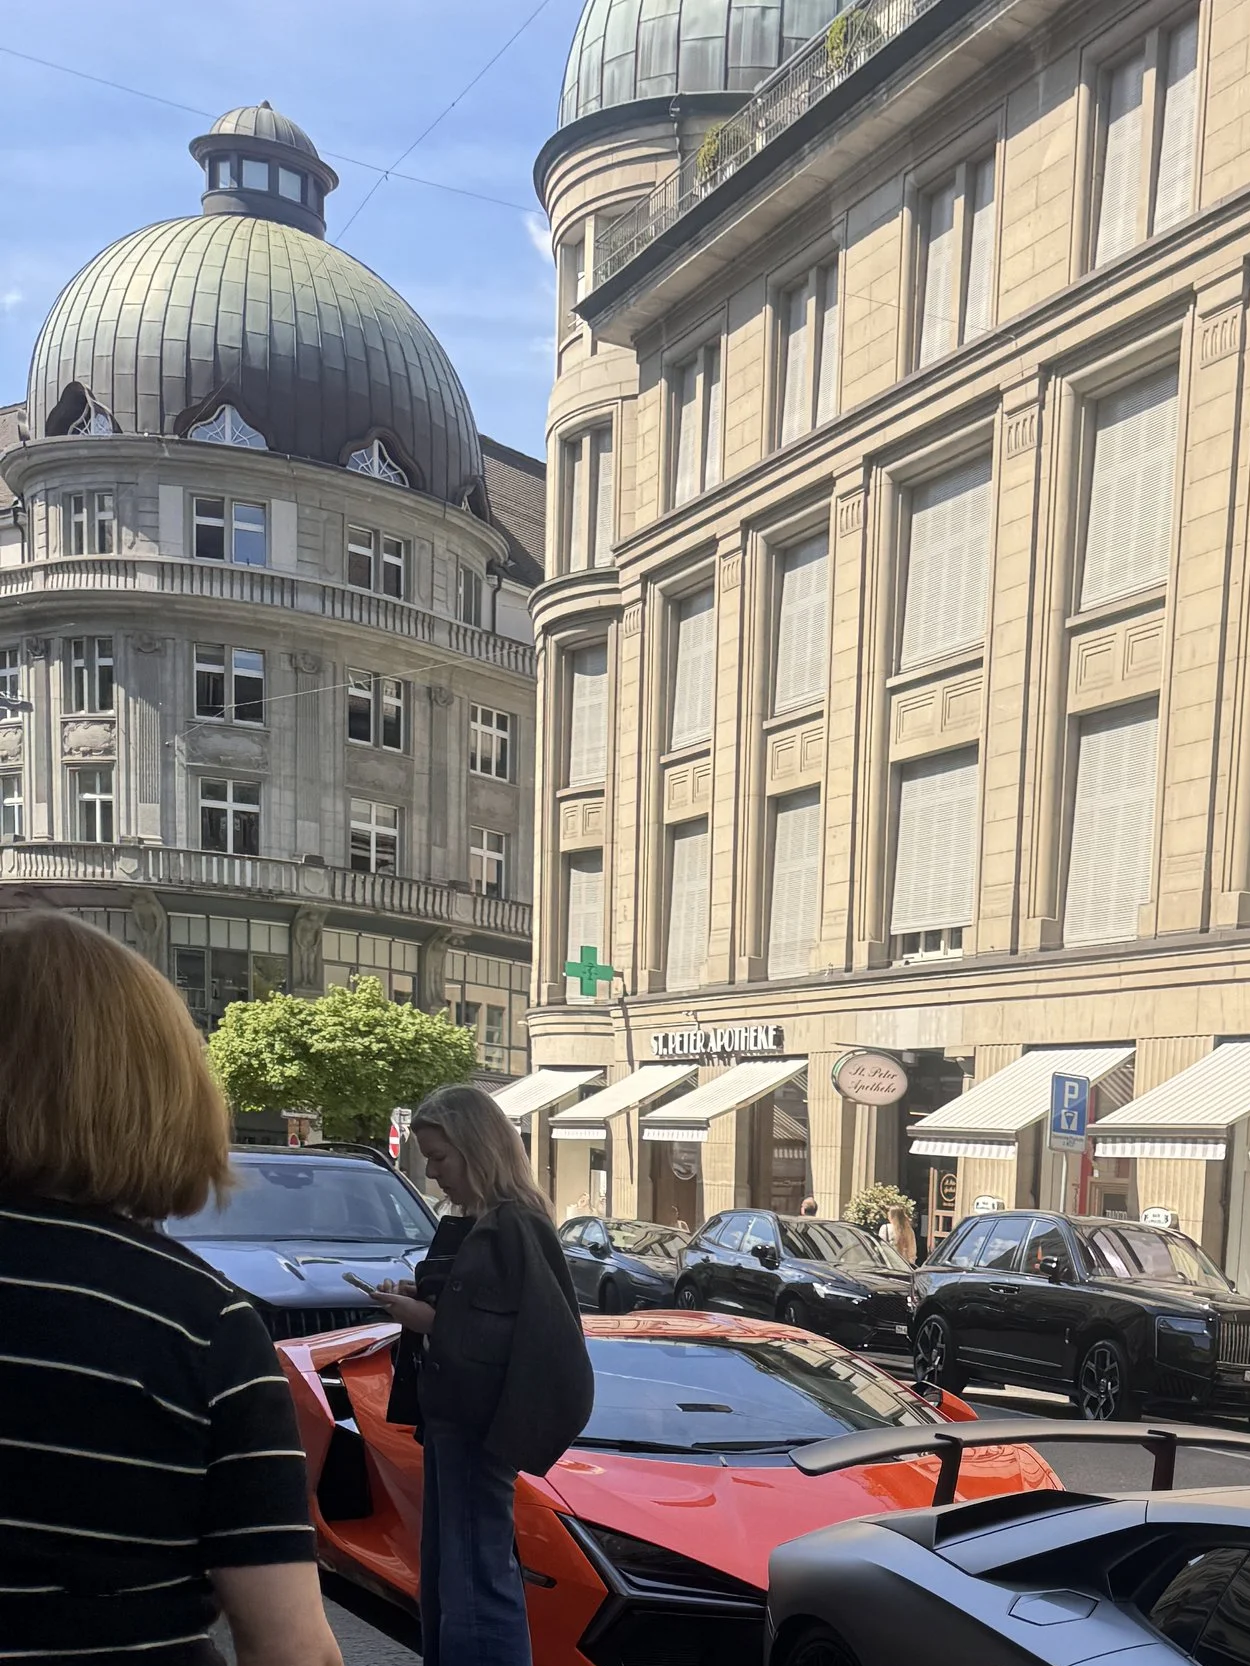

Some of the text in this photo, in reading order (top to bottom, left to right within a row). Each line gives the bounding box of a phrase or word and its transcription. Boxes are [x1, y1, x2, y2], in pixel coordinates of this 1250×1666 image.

[668, 1029, 706, 1055] PETER
[707, 1025, 777, 1053] APOTHEKE
[869, 1066, 898, 1079] Peter
[848, 1080, 897, 1093] Apotheke
[1063, 1081, 1079, 1109] P
